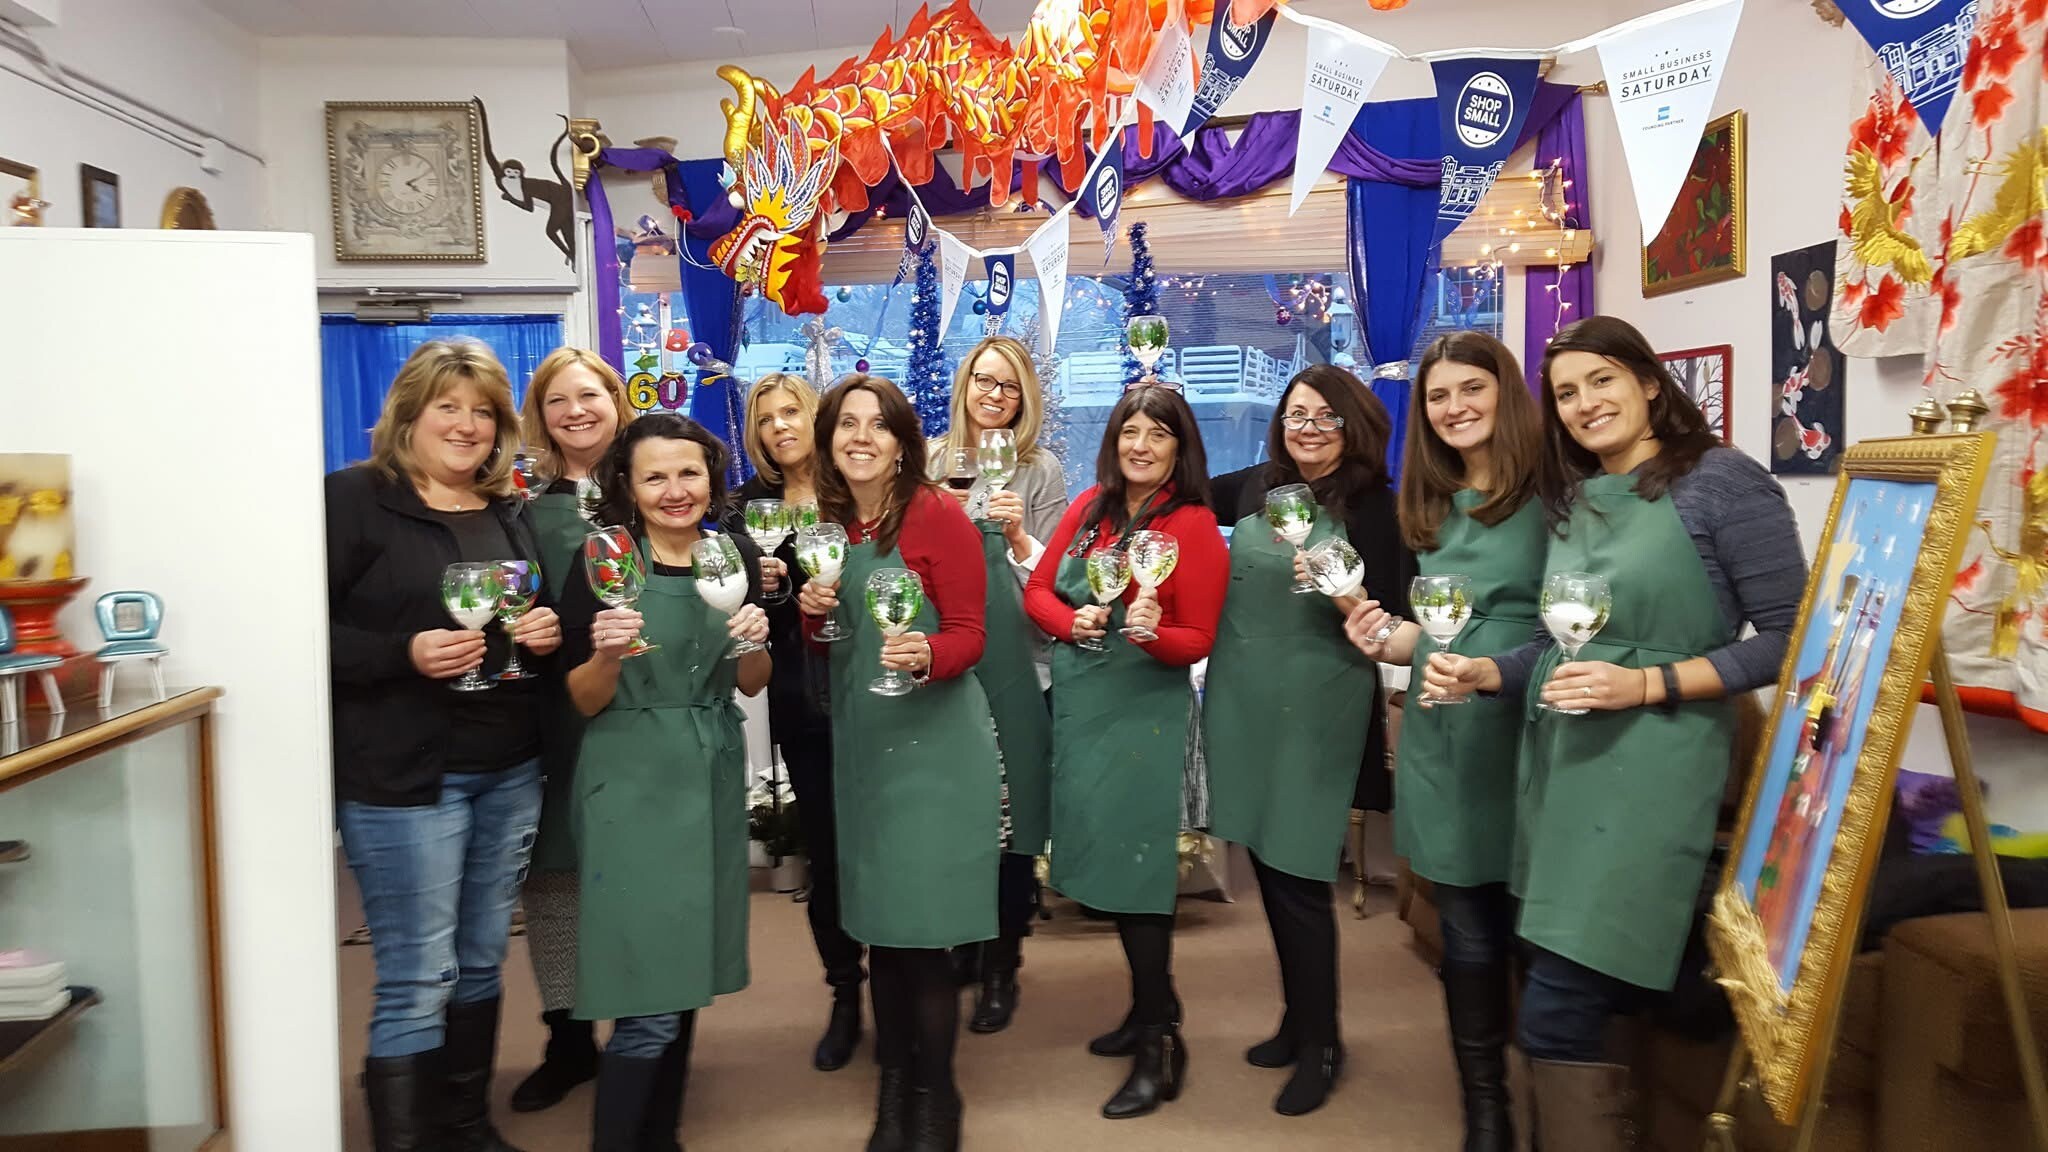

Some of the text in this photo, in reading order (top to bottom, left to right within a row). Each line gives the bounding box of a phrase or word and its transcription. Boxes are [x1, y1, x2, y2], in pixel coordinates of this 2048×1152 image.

[1315, 62, 1363, 86] SMALL BUSINESS
[1622, 50, 1711, 80] SMALL BUSINESS
[1311, 73, 1360, 101] SATURDAY
[1621, 65, 1711, 98] SATURDAY
[1463, 107, 1500, 127] SMALL
[1469, 94, 1502, 113] SHOP
[627, 372, 688, 410] 60
